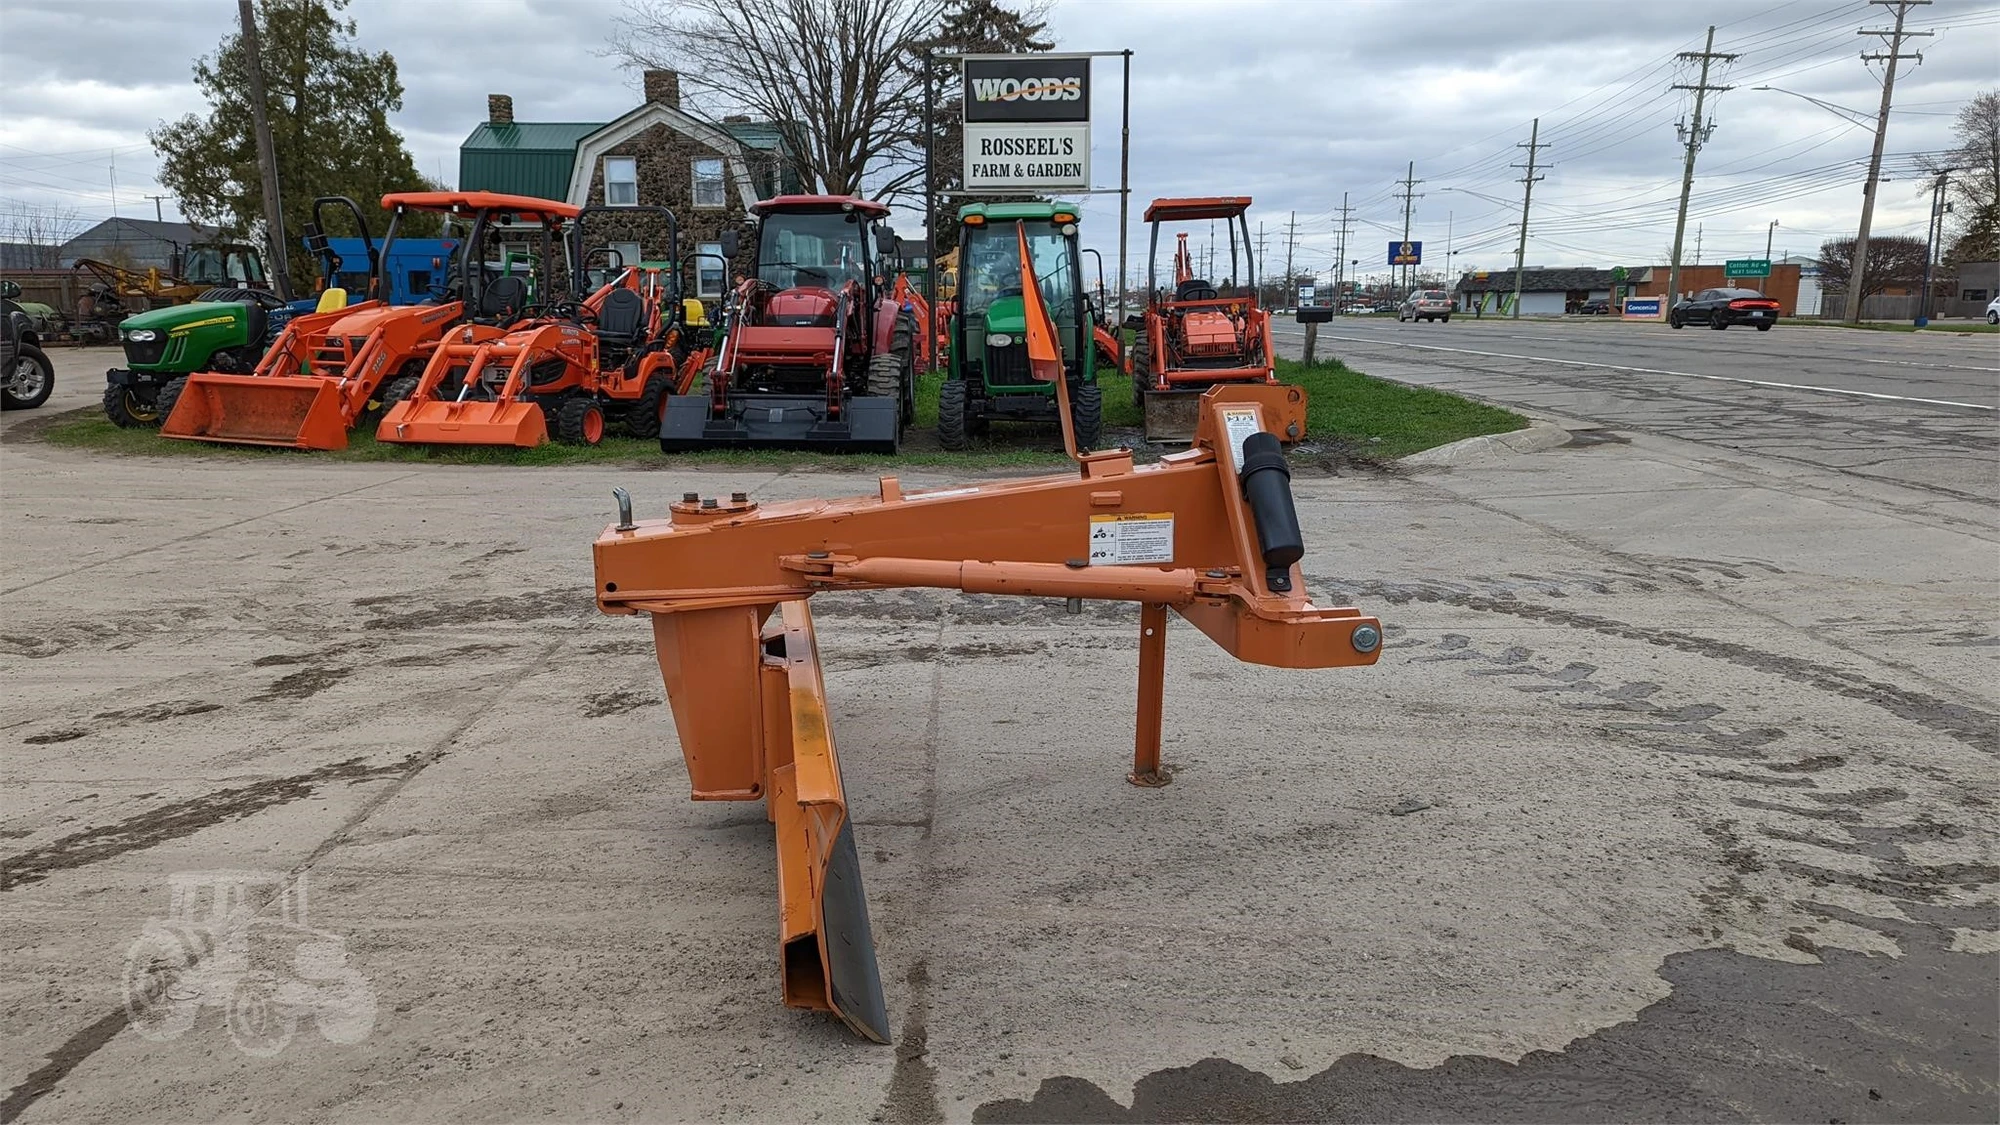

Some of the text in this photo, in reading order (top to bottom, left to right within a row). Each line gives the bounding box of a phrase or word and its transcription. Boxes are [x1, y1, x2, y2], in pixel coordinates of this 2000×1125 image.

[972, 77, 1081, 102] WOODS
[981, 137, 1073, 156] ROSSEEL'S
[972, 163, 1082, 178] FARM & GARDEN
